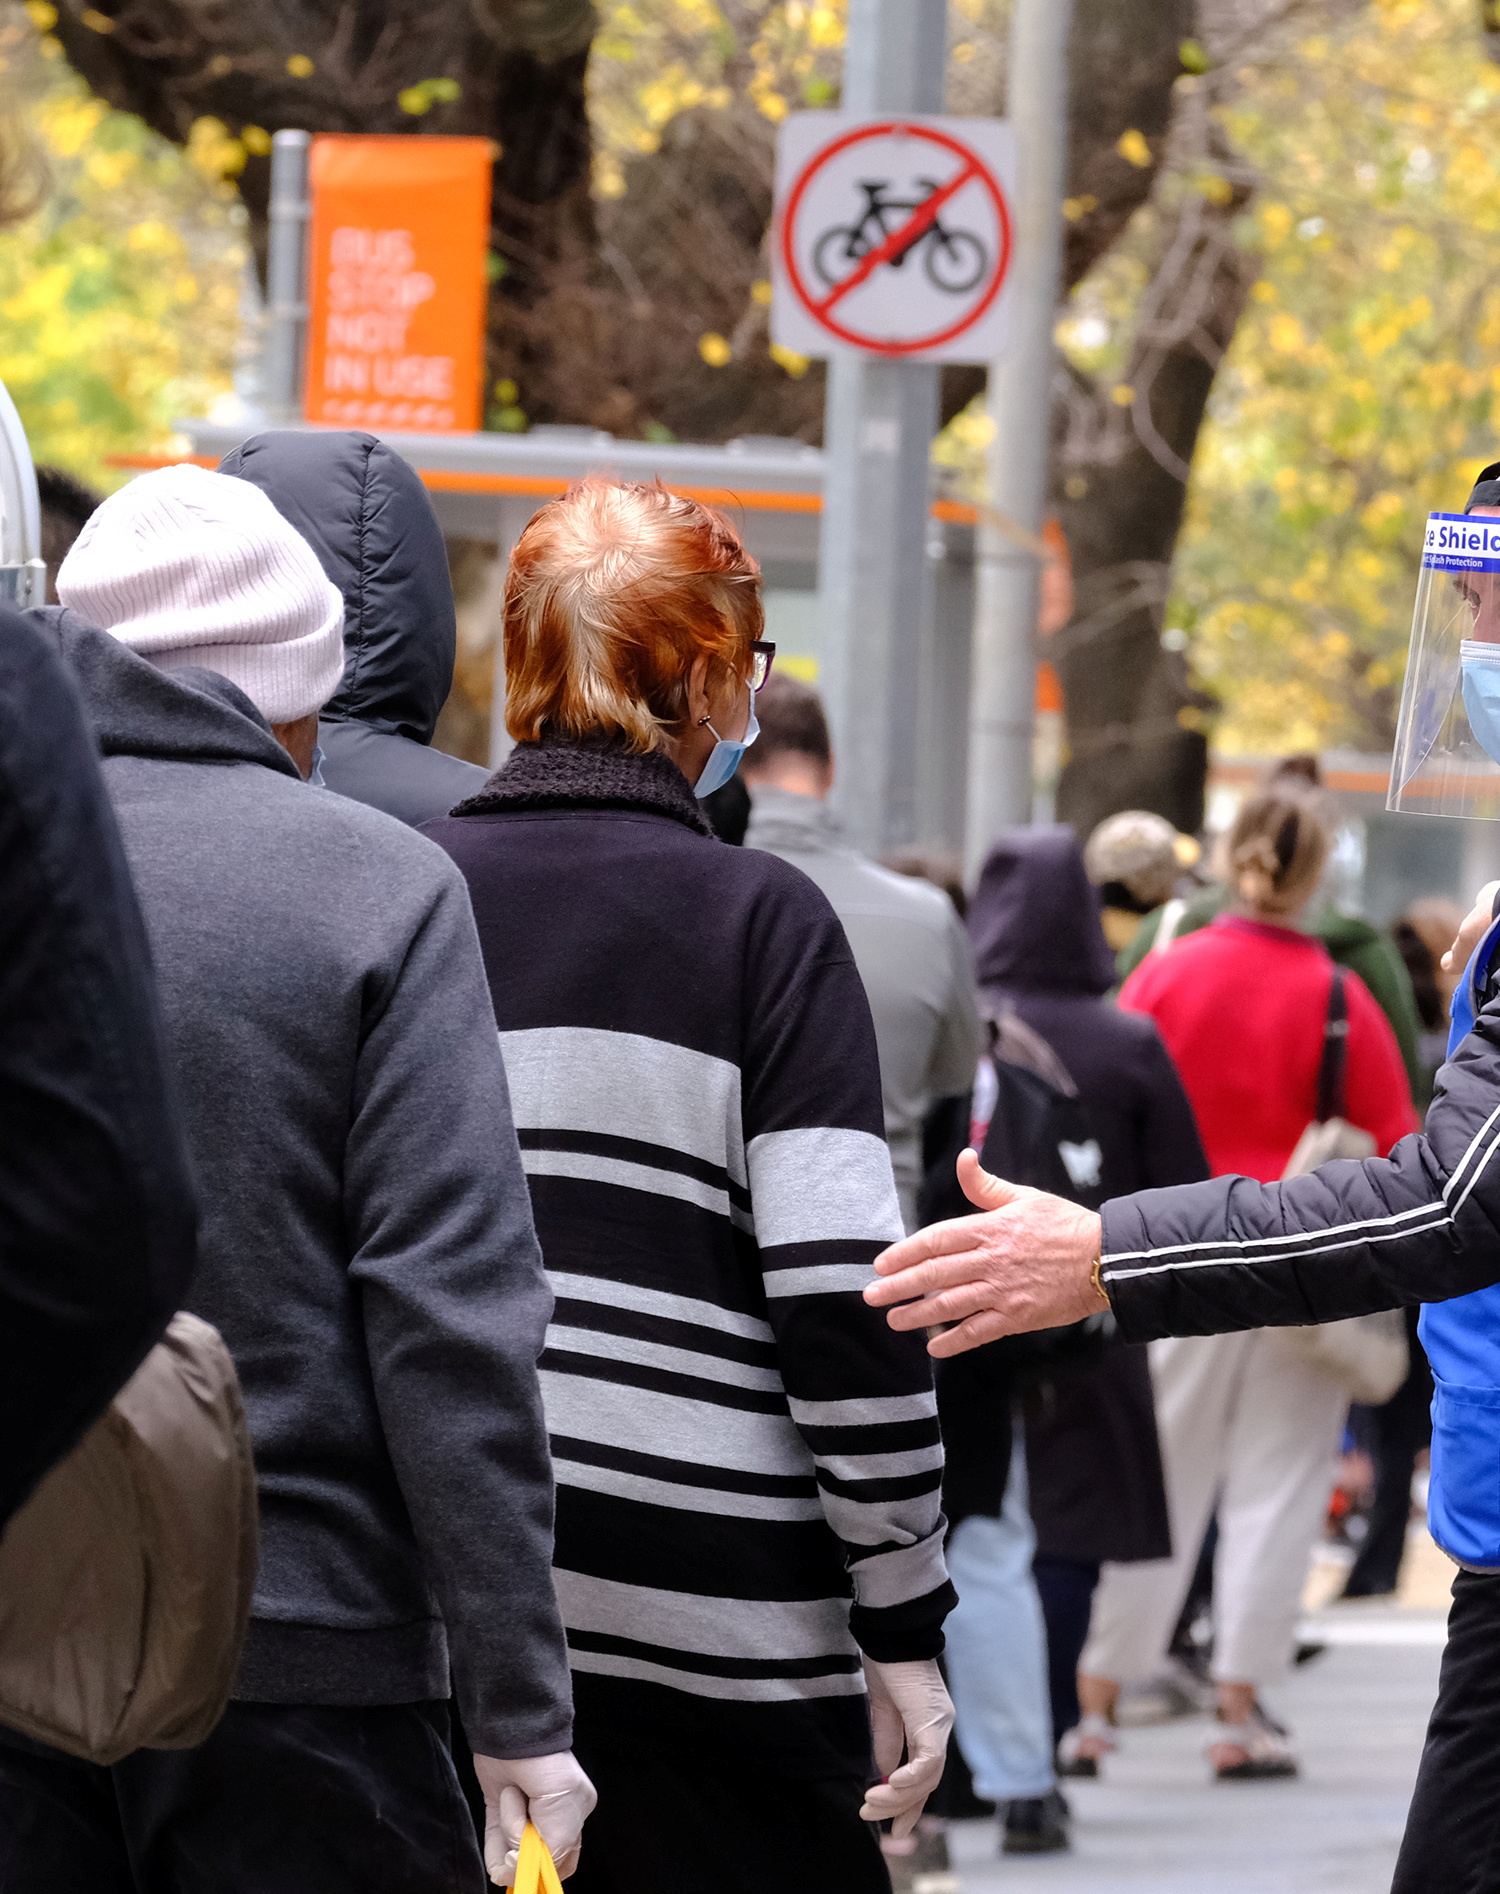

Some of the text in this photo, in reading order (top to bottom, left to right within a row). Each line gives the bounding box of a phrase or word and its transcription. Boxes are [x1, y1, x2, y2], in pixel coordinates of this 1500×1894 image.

[331, 227, 415, 268] BUS
[328, 271, 436, 310] STOP
[327, 312, 411, 352] NOT
[325, 354, 454, 399] IN USE
[1445, 556, 1483, 568] Protection
